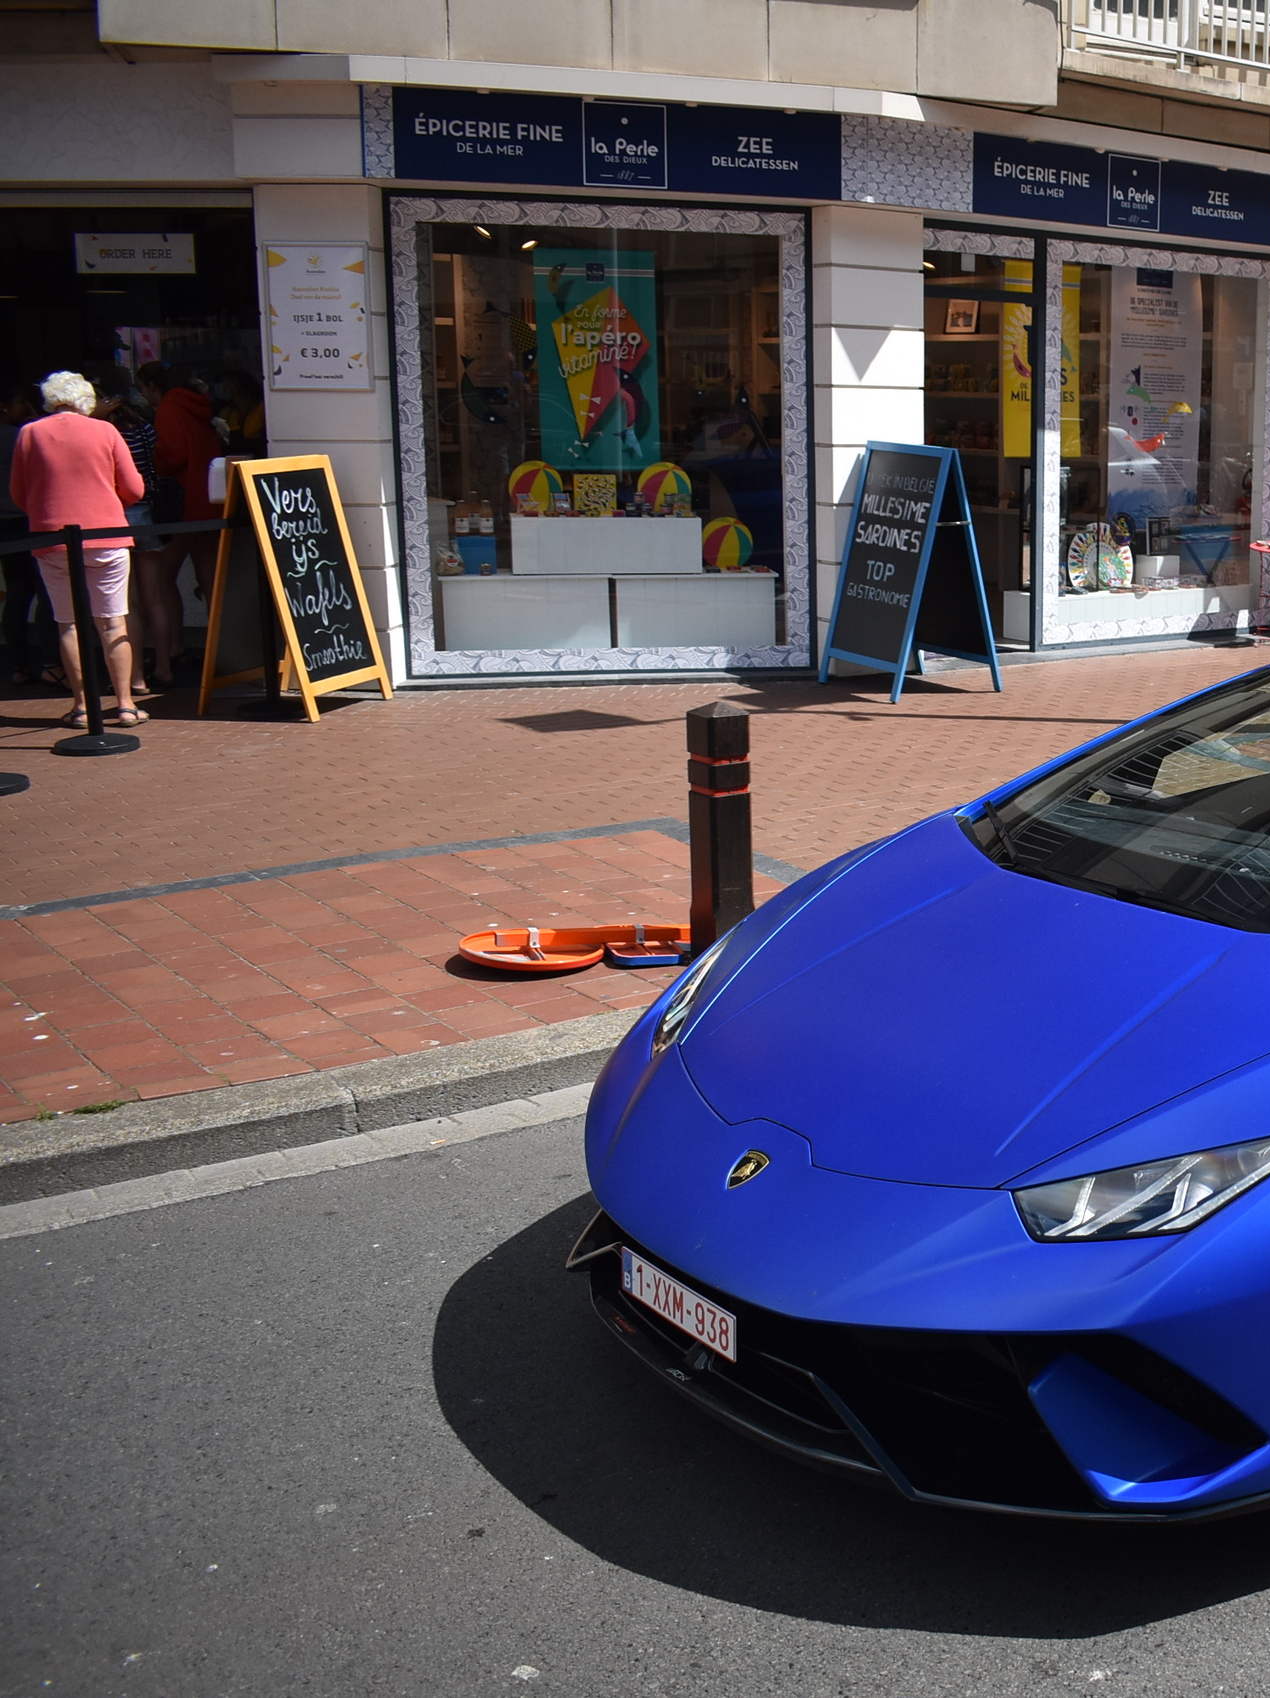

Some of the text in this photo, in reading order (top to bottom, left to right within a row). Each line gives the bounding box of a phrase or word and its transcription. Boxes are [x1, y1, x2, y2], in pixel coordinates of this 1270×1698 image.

[414, 112, 563, 142] ÉPICERIE FINE
[456, 142, 524, 156] DE LA MER
[591, 136, 659, 156] la Perle
[737, 136, 774, 154] ZEE
[604, 155, 648, 164] DES DIEUX
[711, 156, 799, 171] DELICATESSEN
[994, 156, 1090, 188] ÉPICERIE FINE
[1020, 184, 1065, 199] DE LA MER
[1112, 184, 1155, 204] la Perle
[1207, 190, 1230, 206] ZEE
[1120, 201, 1149, 211] DES DIEUX
[1191, 205, 1245, 221] DELICATESSEN
[99, 248, 172, 259] ORDER HERE
[293, 315, 315, 323] IJSJE
[316, 312, 323, 322] 1
[573, 304, 627, 321] En forme
[301, 348, 340, 359] € 3,00
[261, 477, 316, 515] Vers
[861, 493, 930, 523] MILLESIME
[271, 507, 328, 540] bereid
[855, 521, 922, 553] SARDINES
[866, 560, 895, 581] TOP
[285, 569, 352, 626] Wafels
[847, 583, 910, 608] GASTRONOMIE
[304, 634, 367, 672] Smoothie
[624, 1264, 730, 1352] B 1-XXM-938
